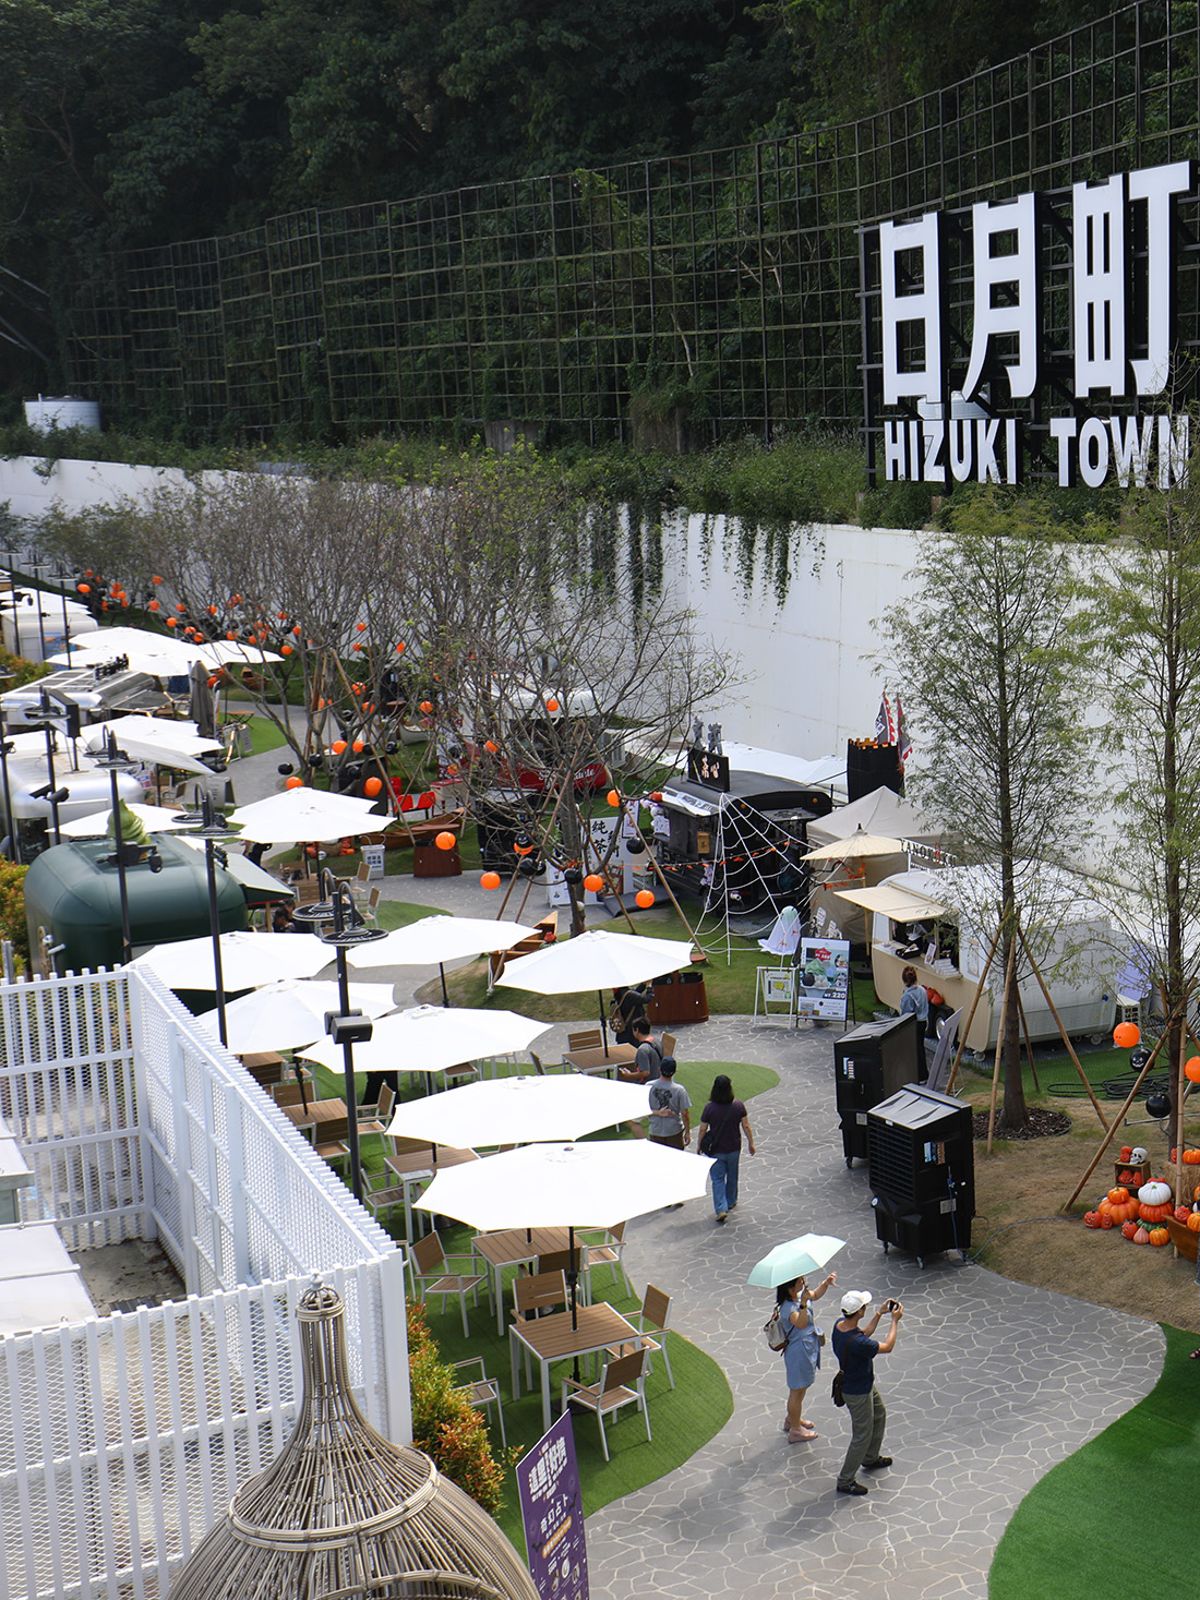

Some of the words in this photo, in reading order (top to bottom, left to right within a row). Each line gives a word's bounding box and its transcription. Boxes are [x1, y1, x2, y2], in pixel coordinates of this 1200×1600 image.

[879, 160, 1190, 406] 日月町
[884, 418, 1018, 485] HIZUKI
[1050, 415, 1189, 490] TOWN
